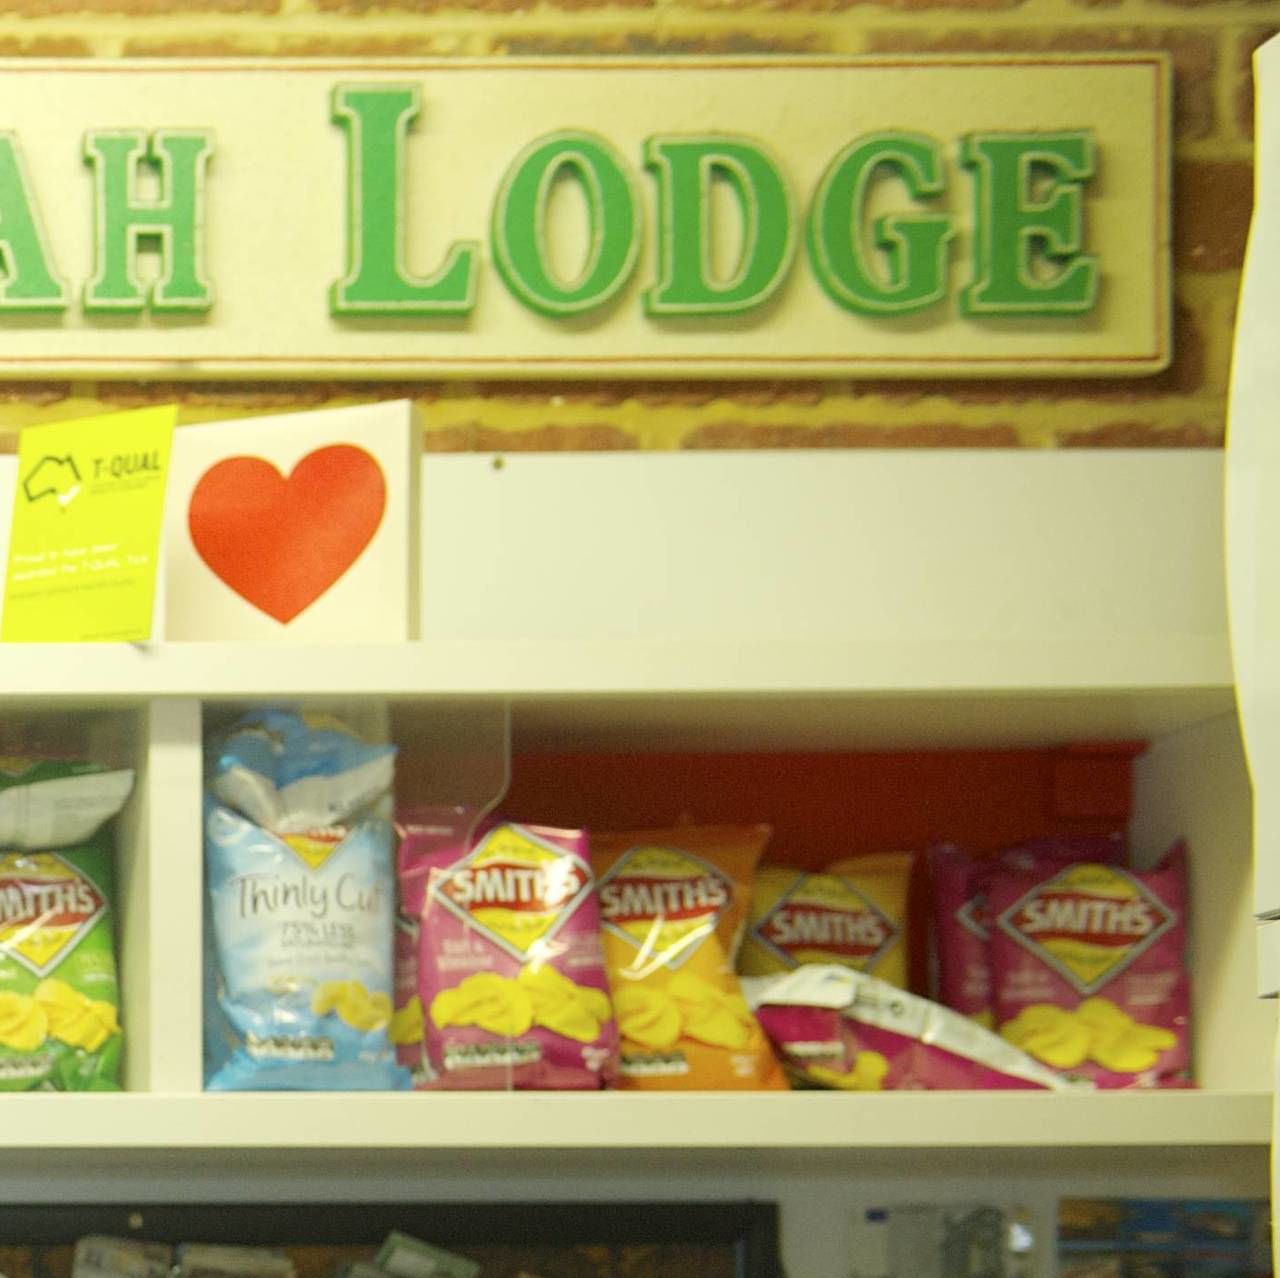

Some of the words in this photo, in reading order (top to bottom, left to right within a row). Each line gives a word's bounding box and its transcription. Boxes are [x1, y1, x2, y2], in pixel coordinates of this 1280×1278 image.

[329, 82, 1100, 318] LODGE
[93, 450, 161, 478] T-QUAL
[228, 873, 329, 920] Thinly
